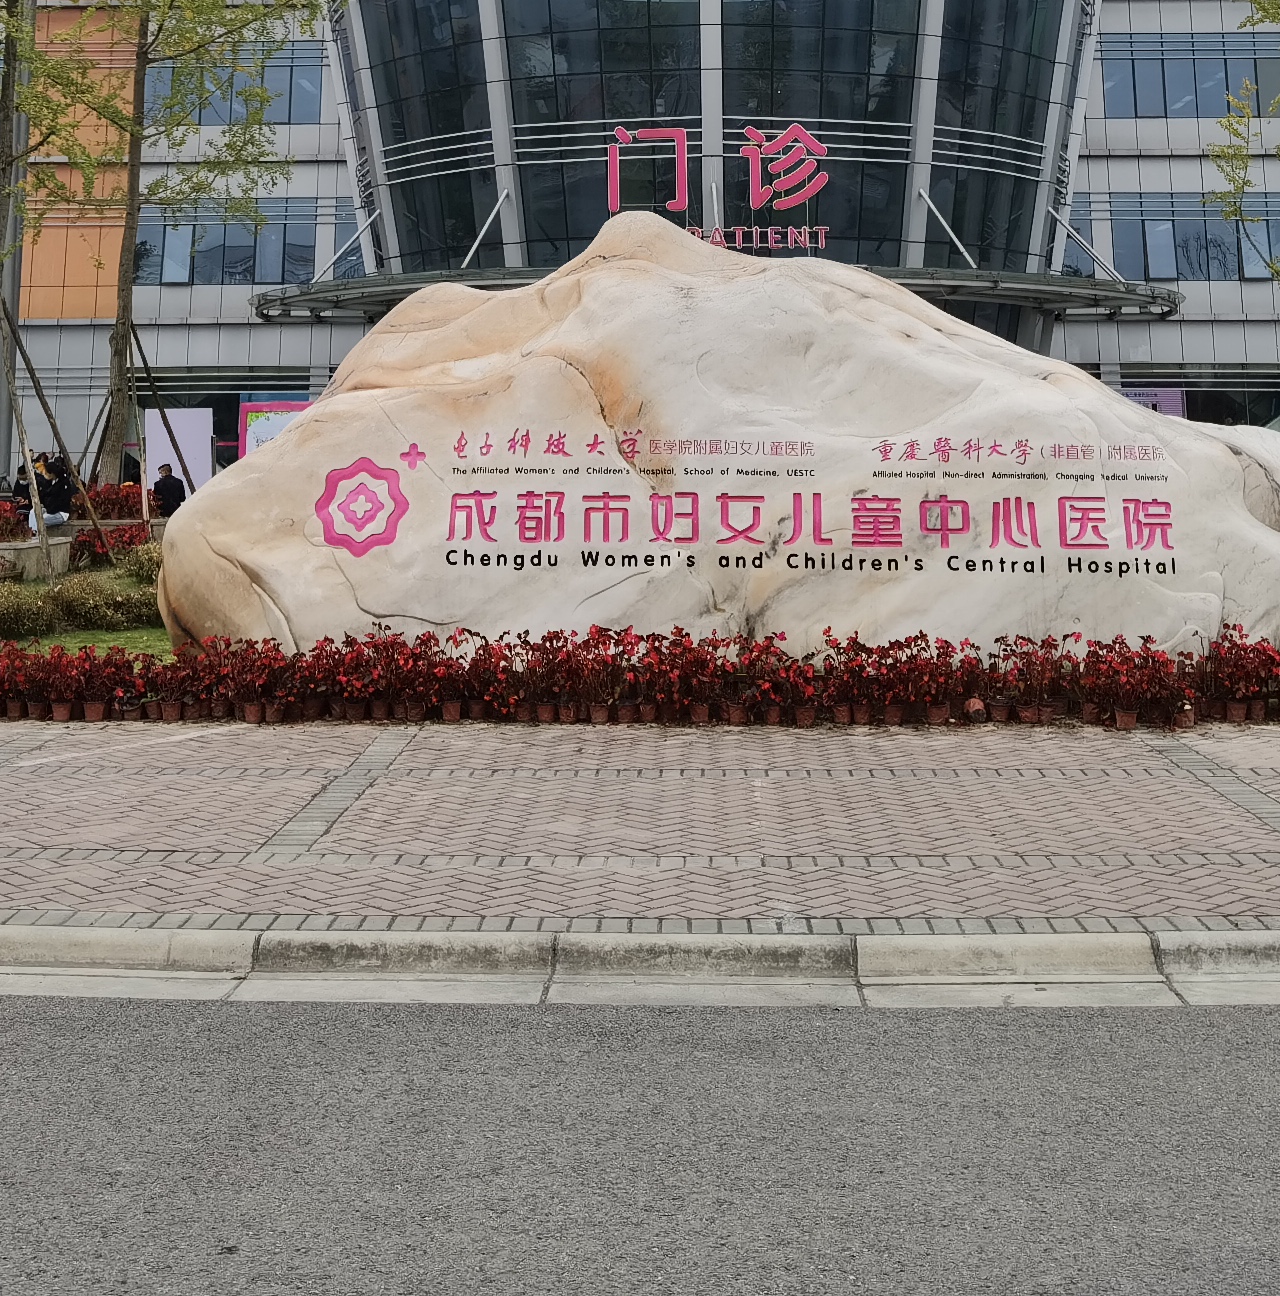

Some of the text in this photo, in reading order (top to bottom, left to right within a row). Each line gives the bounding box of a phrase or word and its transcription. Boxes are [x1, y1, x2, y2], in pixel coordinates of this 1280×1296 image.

[608, 123, 829, 212] 门诊
[452, 467, 467, 475] The
[471, 467, 509, 475] Affiliated
[515, 467, 556, 475] Women's
[562, 467, 580, 475] and
[586, 467, 630, 475] Children's
[639, 467, 677, 477] Hospital,
[683, 467, 714, 475] School
[720, 467, 729, 476] of
[786, 469, 816, 477] UESTC
[906, 470, 936, 480] Hospital
[1055, 472, 1095, 482] Chongqing
[1135, 473, 1169, 483] University
[445, 490, 1175, 551] 成都市妇女儿童中心医院
[445, 549, 1177, 577] Chengdu Women's and Children's Central Hospital
